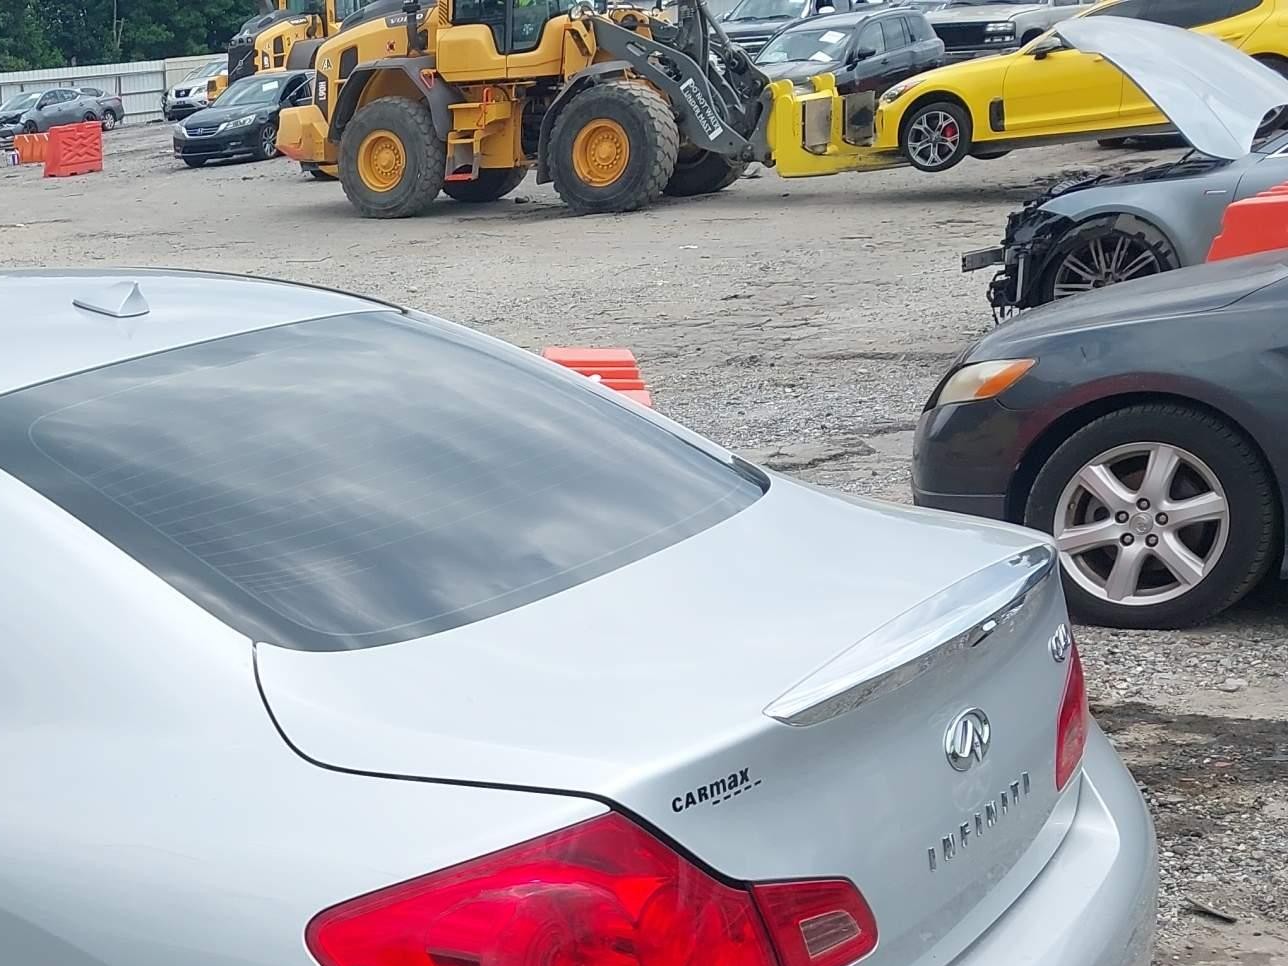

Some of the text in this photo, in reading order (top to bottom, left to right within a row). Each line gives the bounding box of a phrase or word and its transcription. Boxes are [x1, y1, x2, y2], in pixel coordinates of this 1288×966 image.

[318, 81, 327, 101] L90H
[685, 91, 712, 132] UNDER MAST
[689, 80, 720, 130] DO NOT WALK
[928, 770, 1031, 872] INFINITI
